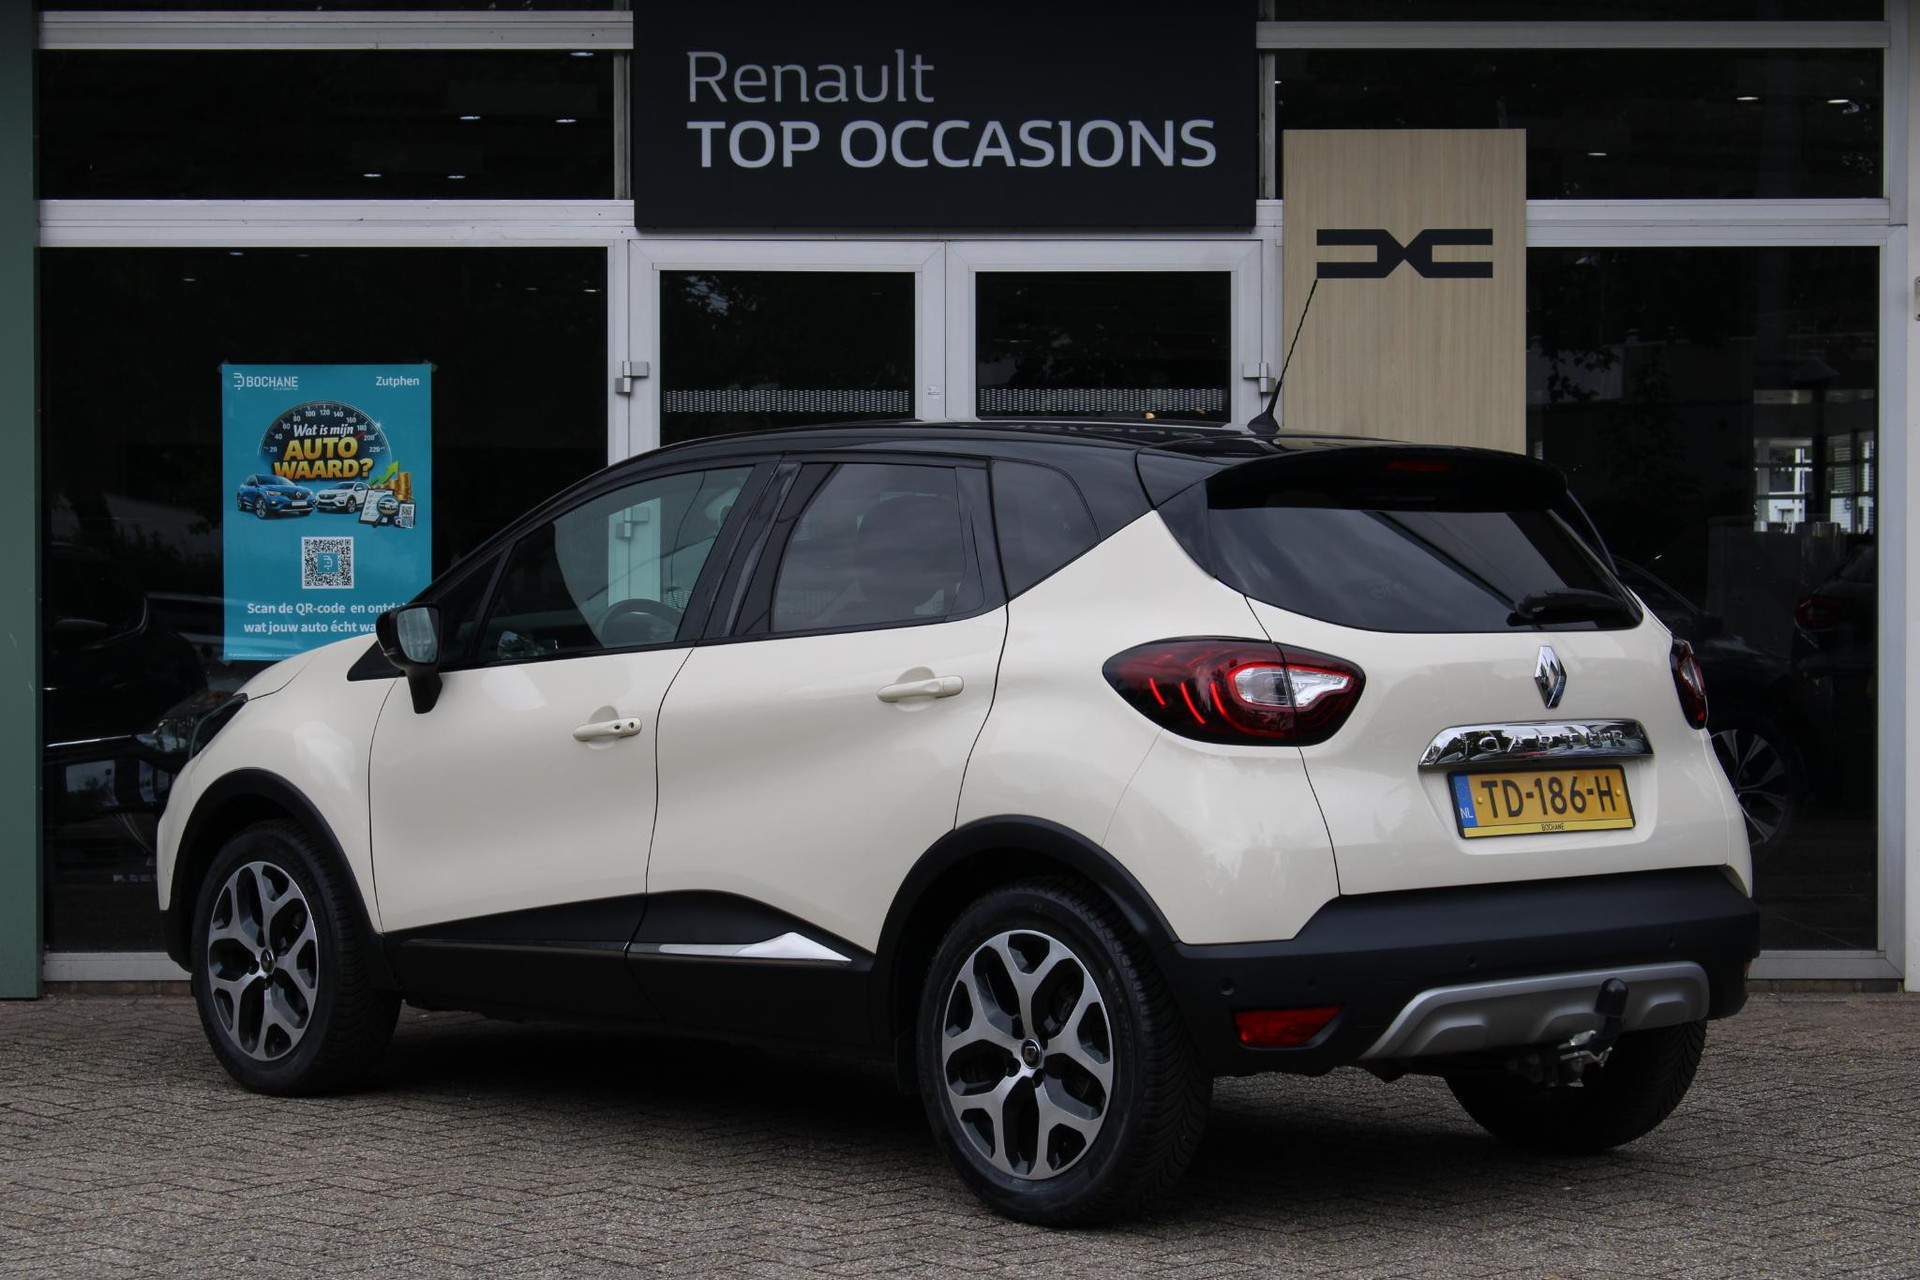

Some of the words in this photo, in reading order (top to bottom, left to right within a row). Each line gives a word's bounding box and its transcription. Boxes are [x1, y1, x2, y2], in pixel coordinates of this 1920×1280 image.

[686, 49, 935, 104] Renault
[686, 120, 821, 168] TOP
[839, 119, 1218, 169] OCCASIONS
[246, 376, 299, 388] BOCHANE
[375, 376, 420, 387] Zutphen
[293, 424, 317, 437] Wat
[319, 424, 328, 435] is
[329, 424, 354, 438] mijn
[283, 436, 358, 461] AUTO
[273, 458, 374, 479] WAARD?
[247, 602, 276, 615] Scan
[278, 602, 293, 614] de
[295, 602, 346, 616] QR-code
[350, 604, 366, 614] en
[244, 623, 267, 634] wat
[267, 621, 298, 636] jouw
[300, 623, 328, 634] auto
[330, 619, 356, 634] écht
[1478, 729, 1626, 754] CAPTUR
[1480, 775, 1617, 819] TD-186-H
[1460, 808, 1474, 819] NL
[1541, 822, 1565, 831] BOCHANE
